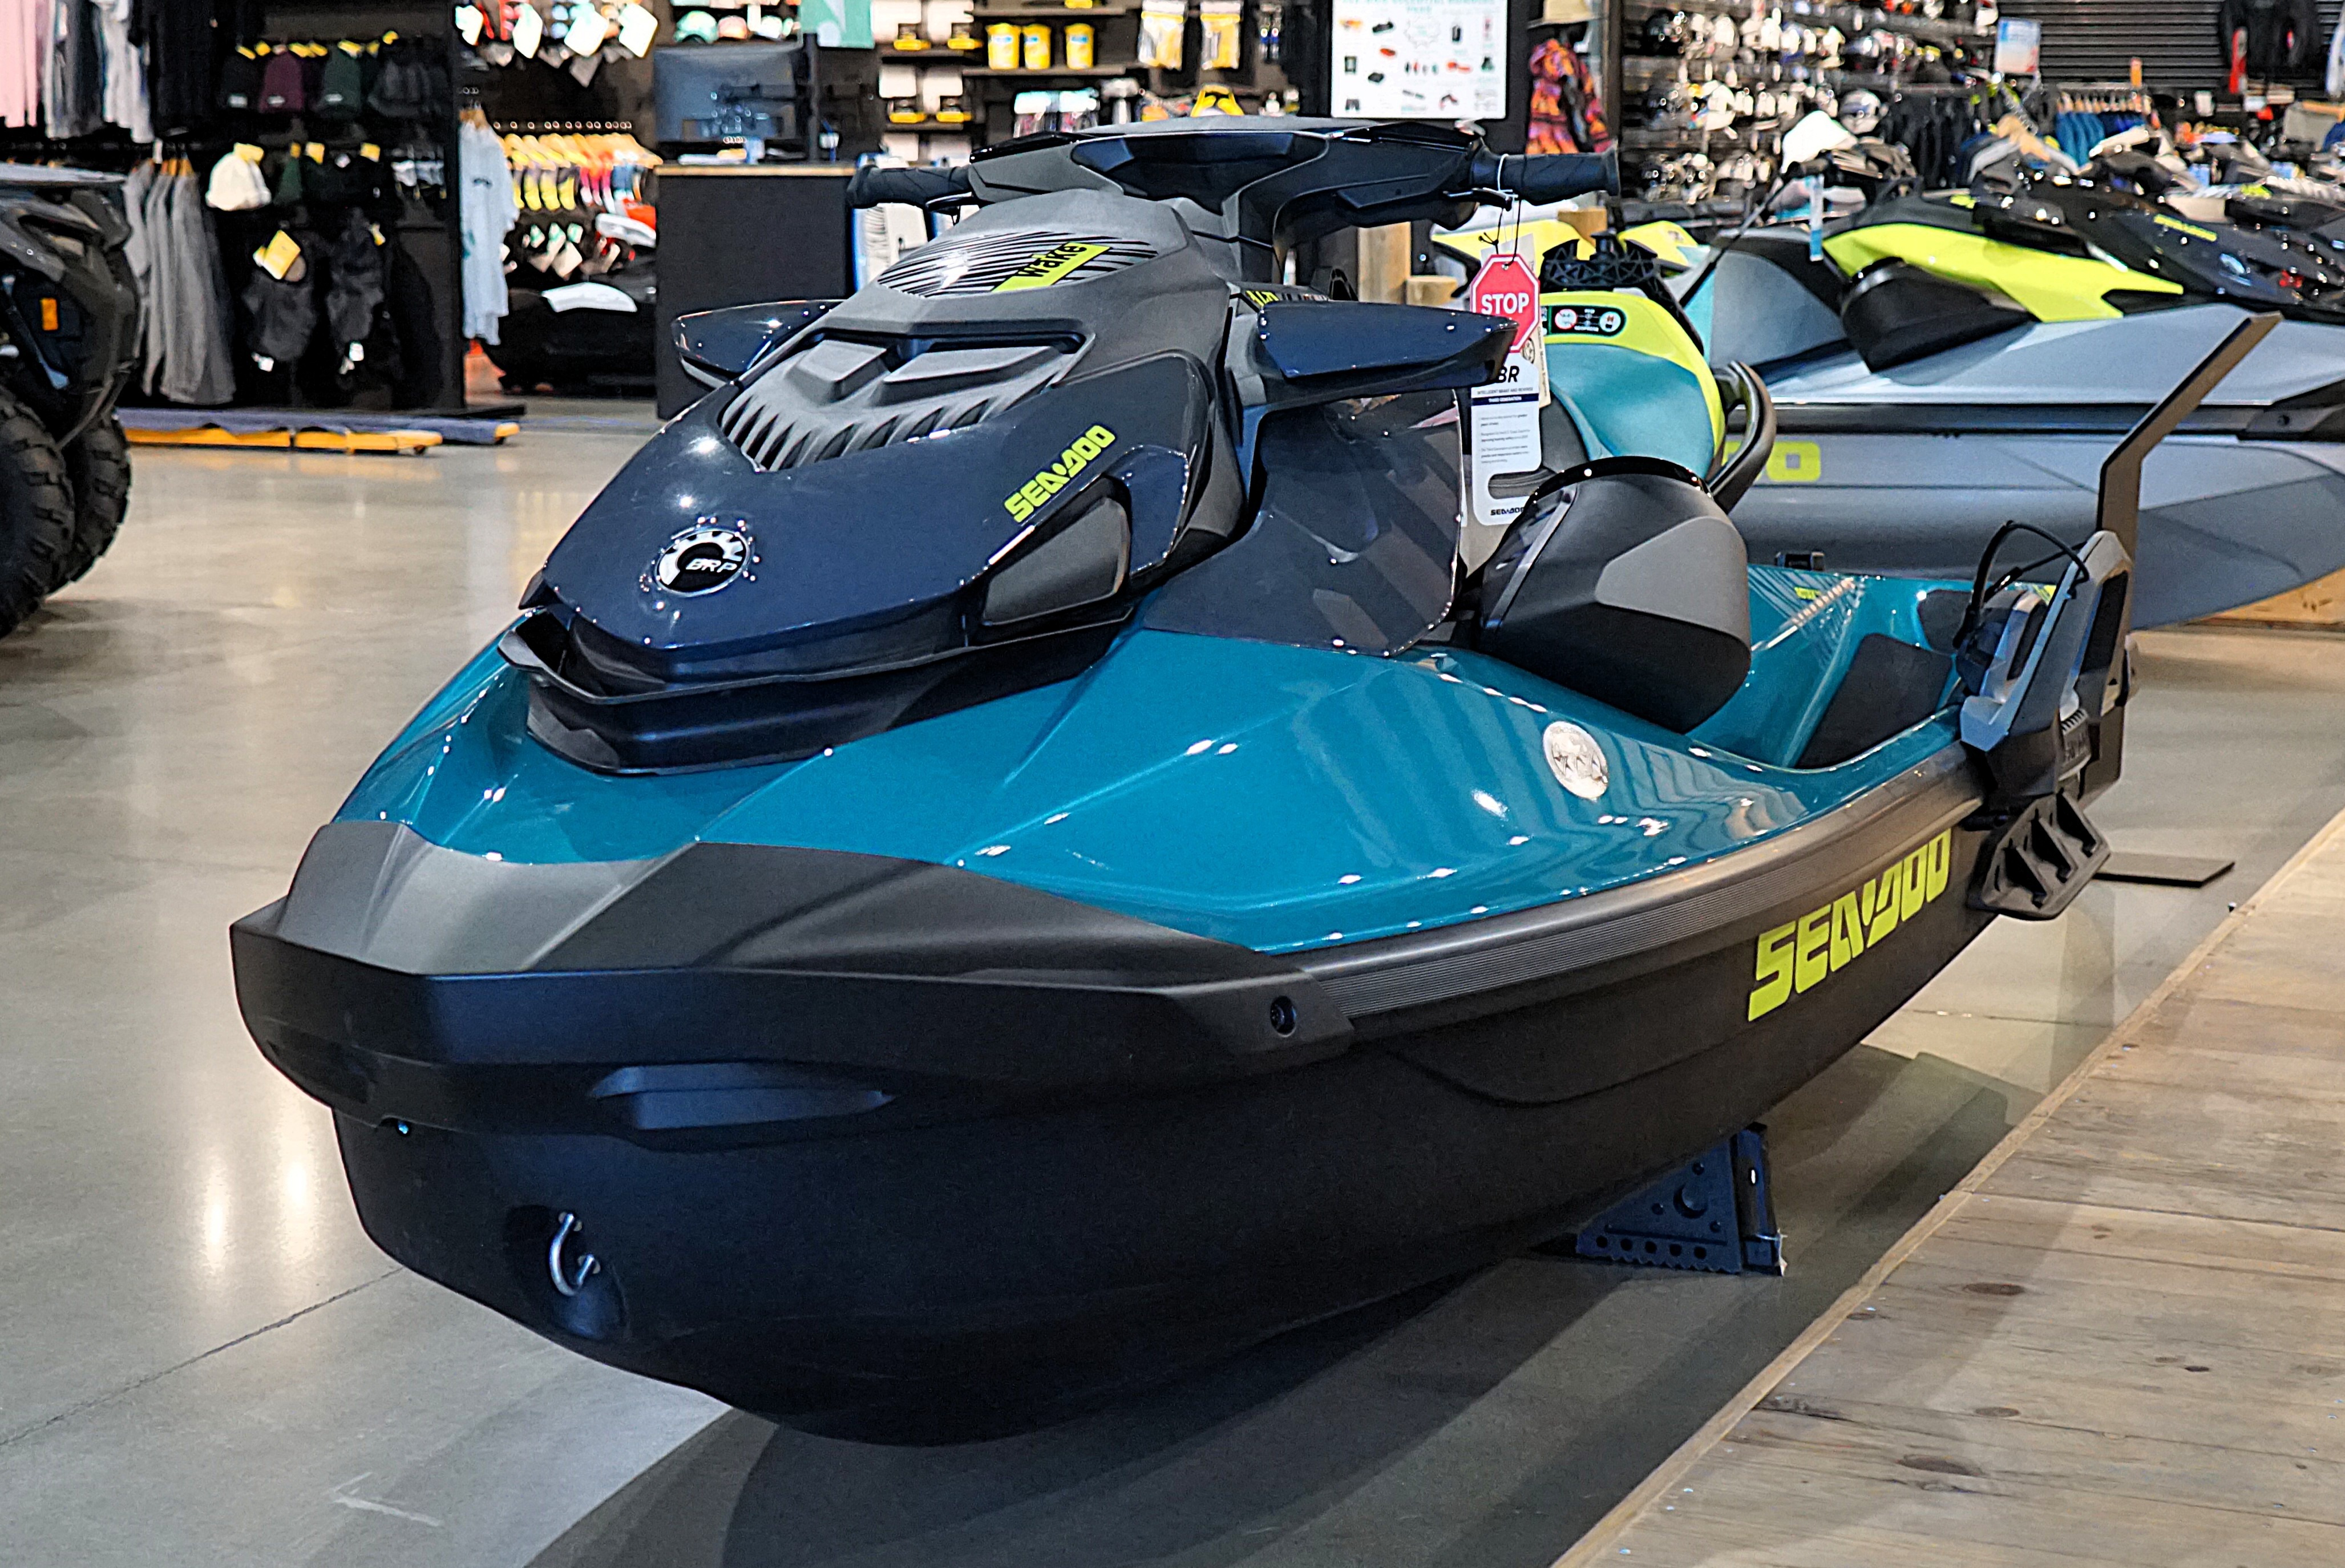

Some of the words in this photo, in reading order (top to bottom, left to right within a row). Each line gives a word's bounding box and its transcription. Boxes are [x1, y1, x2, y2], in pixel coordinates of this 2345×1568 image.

[1016, 246, 1087, 277] wake
[1481, 293, 1530, 314] STOP
[1497, 365, 1519, 383] BR
[686, 557, 738, 573] BRP
